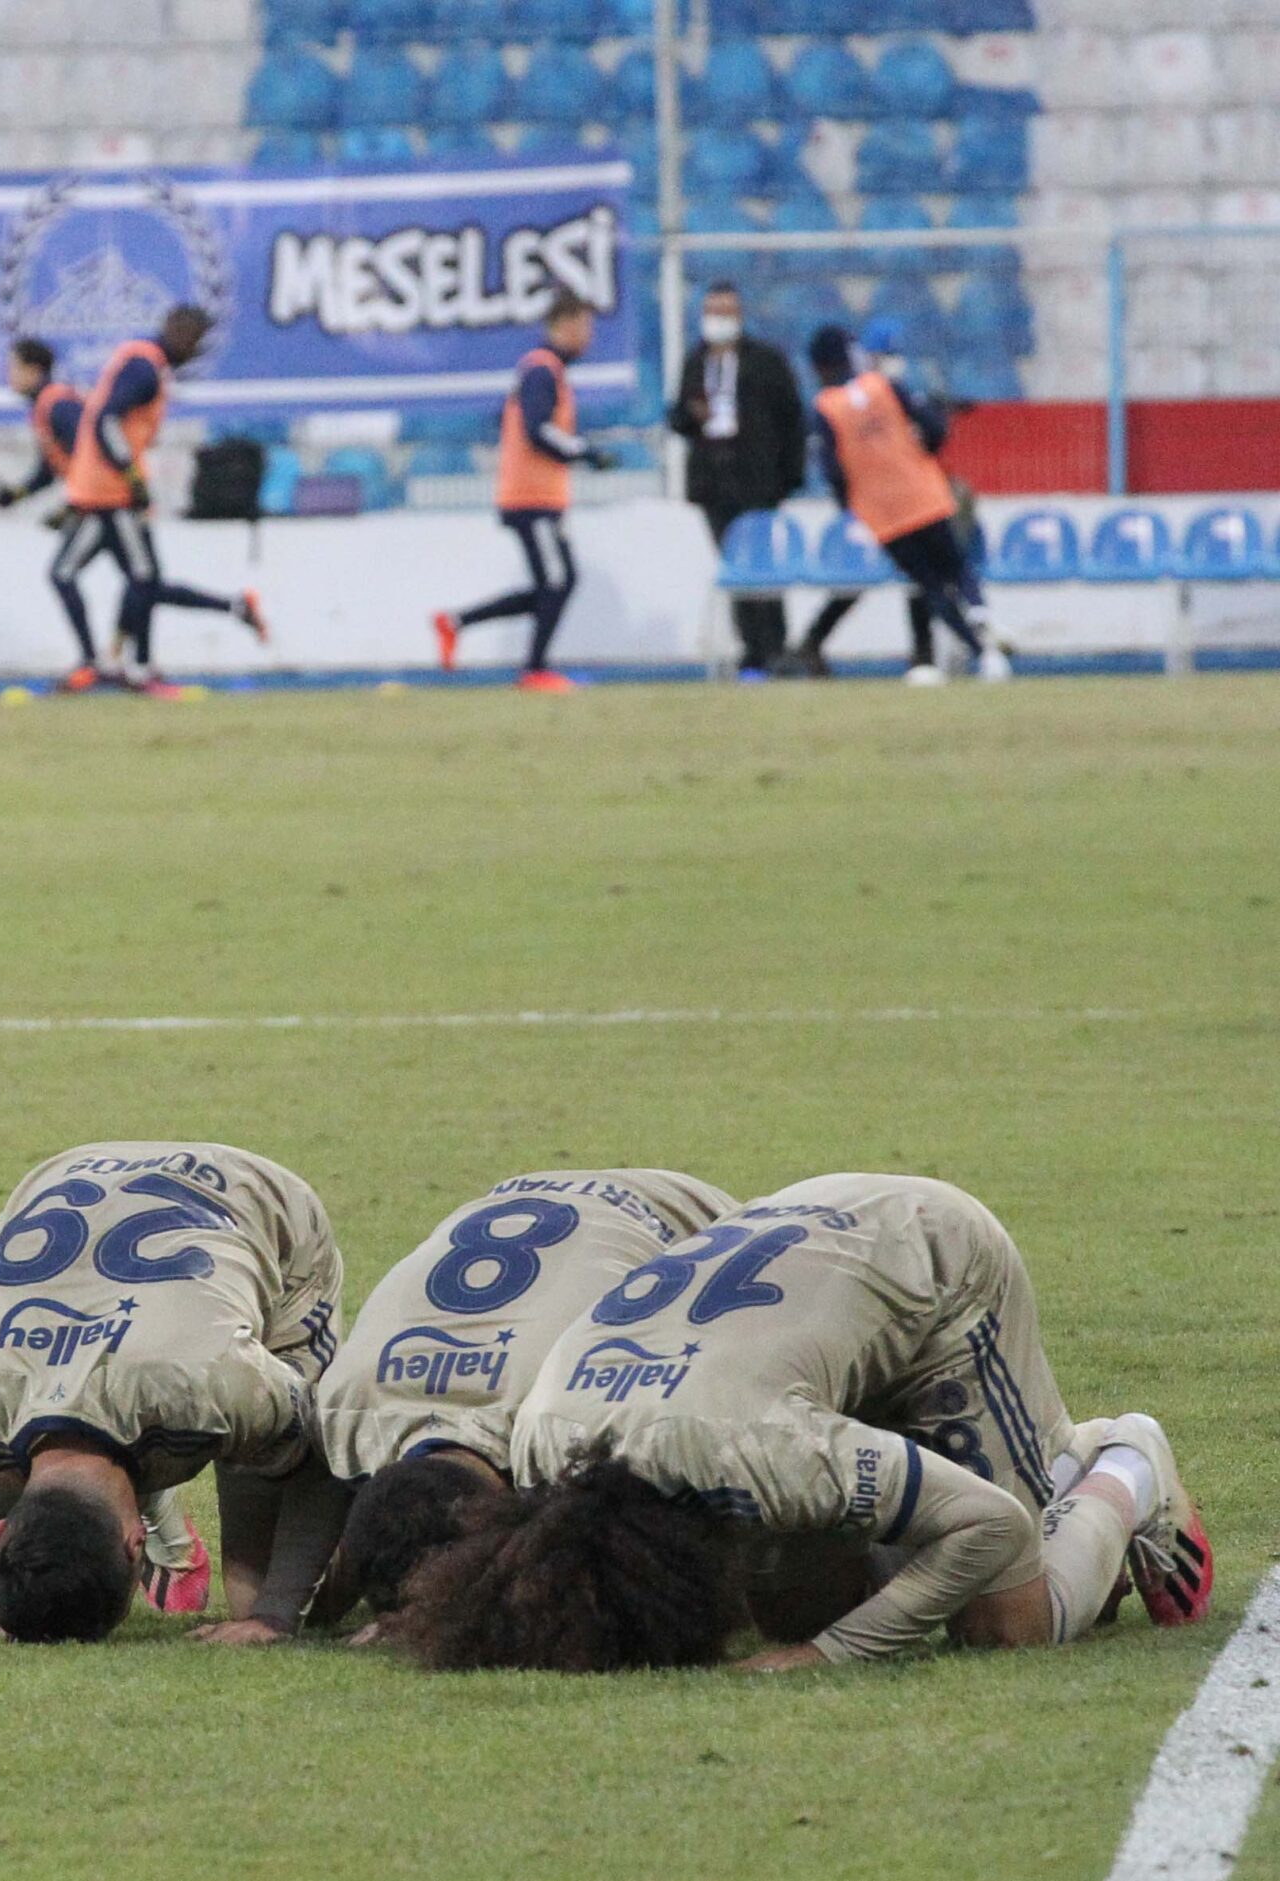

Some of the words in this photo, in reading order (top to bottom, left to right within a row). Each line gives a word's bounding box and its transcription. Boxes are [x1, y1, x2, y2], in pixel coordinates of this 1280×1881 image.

[426, 1197, 580, 1314] 8
[591, 1224, 809, 1326] 18
[376, 1326, 509, 1395] halley
[566, 1337, 691, 1402] halley
